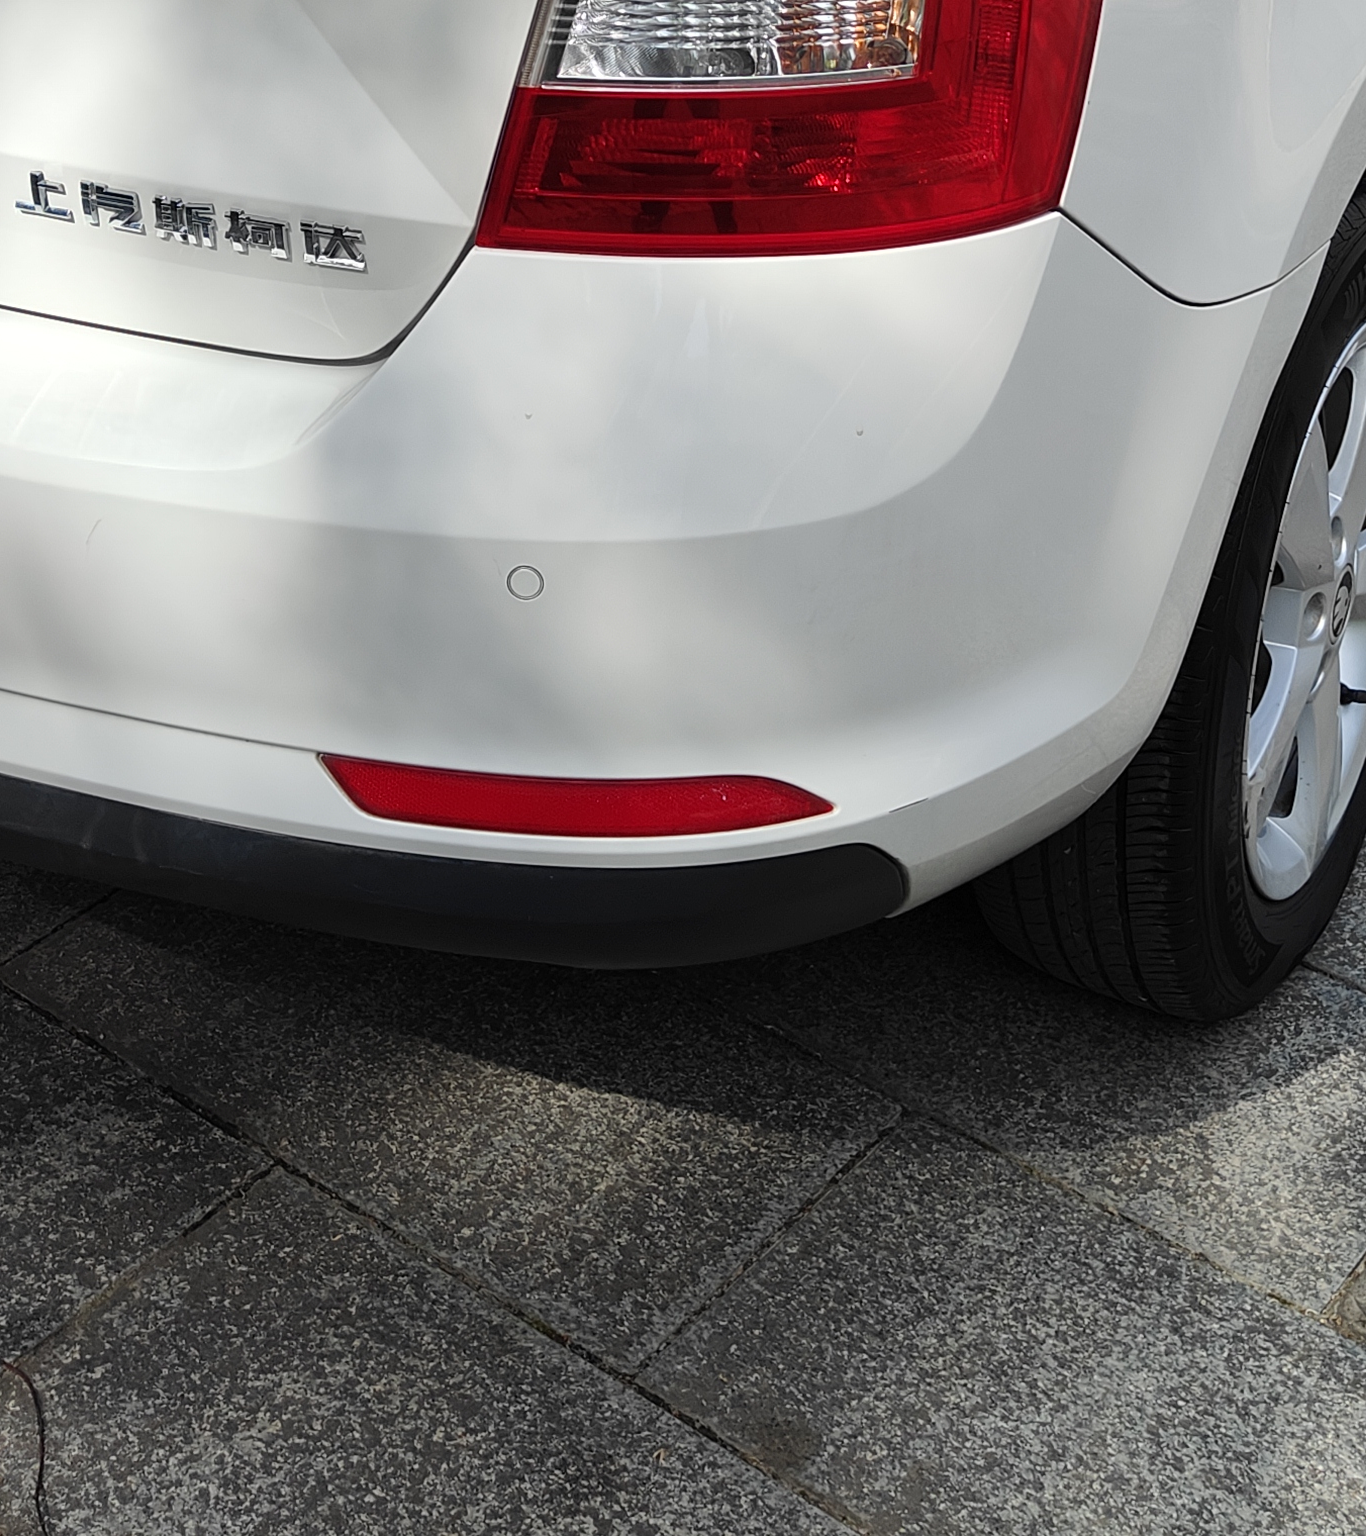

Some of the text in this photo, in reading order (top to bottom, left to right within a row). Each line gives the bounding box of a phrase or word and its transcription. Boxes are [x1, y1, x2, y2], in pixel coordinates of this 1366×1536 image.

[14, 170, 368, 272] 上汽斯柯达
